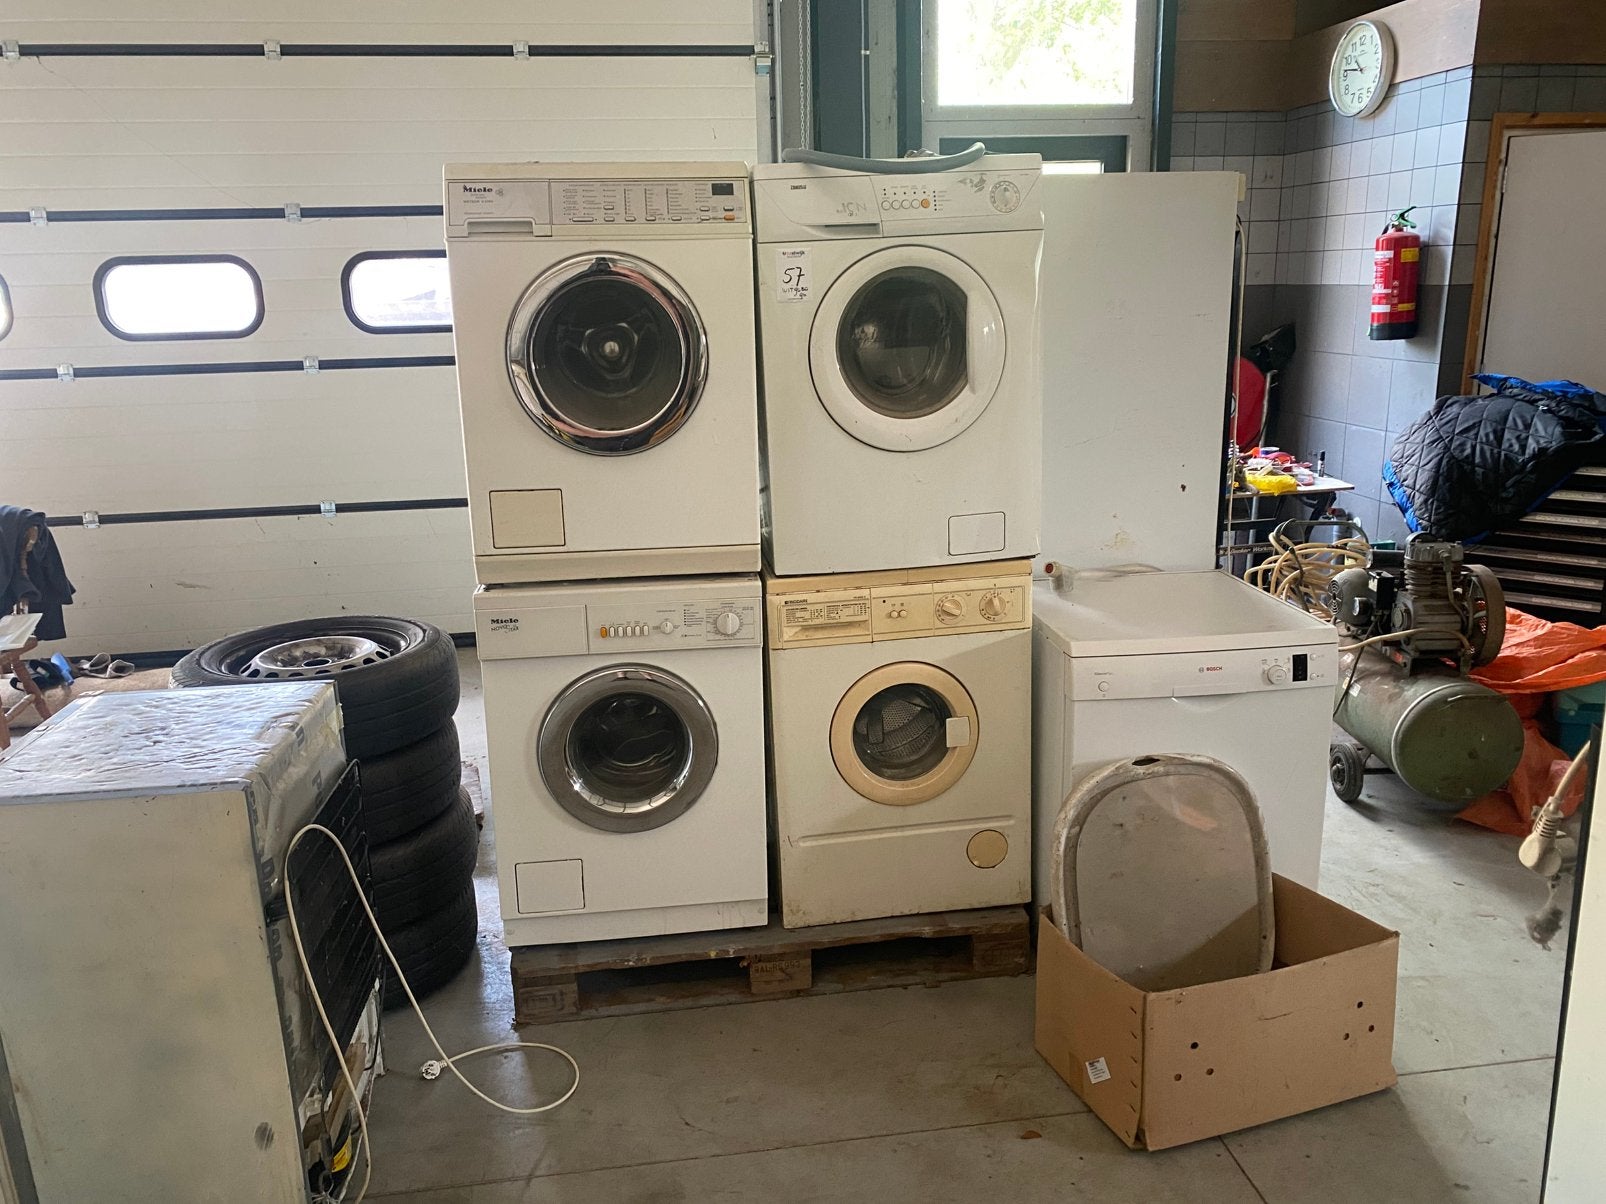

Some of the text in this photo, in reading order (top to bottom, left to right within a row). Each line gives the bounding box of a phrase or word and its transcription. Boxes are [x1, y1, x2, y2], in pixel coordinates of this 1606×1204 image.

[1359, 35, 1367, 46] 12
[1370, 34, 1374, 45] 1
[1351, 42, 1357, 53] 11
[1374, 44, 1380, 54] 2
[1345, 55, 1352, 66] 10
[1343, 70, 1348, 81] 9
[1344, 84, 1349, 95] 8
[1366, 87, 1372, 98] 5
[1350, 93, 1356, 104] 7
[1357, 93, 1363, 103] 6
[463, 185, 493, 193] Miele
[783, 266, 805, 286] 57
